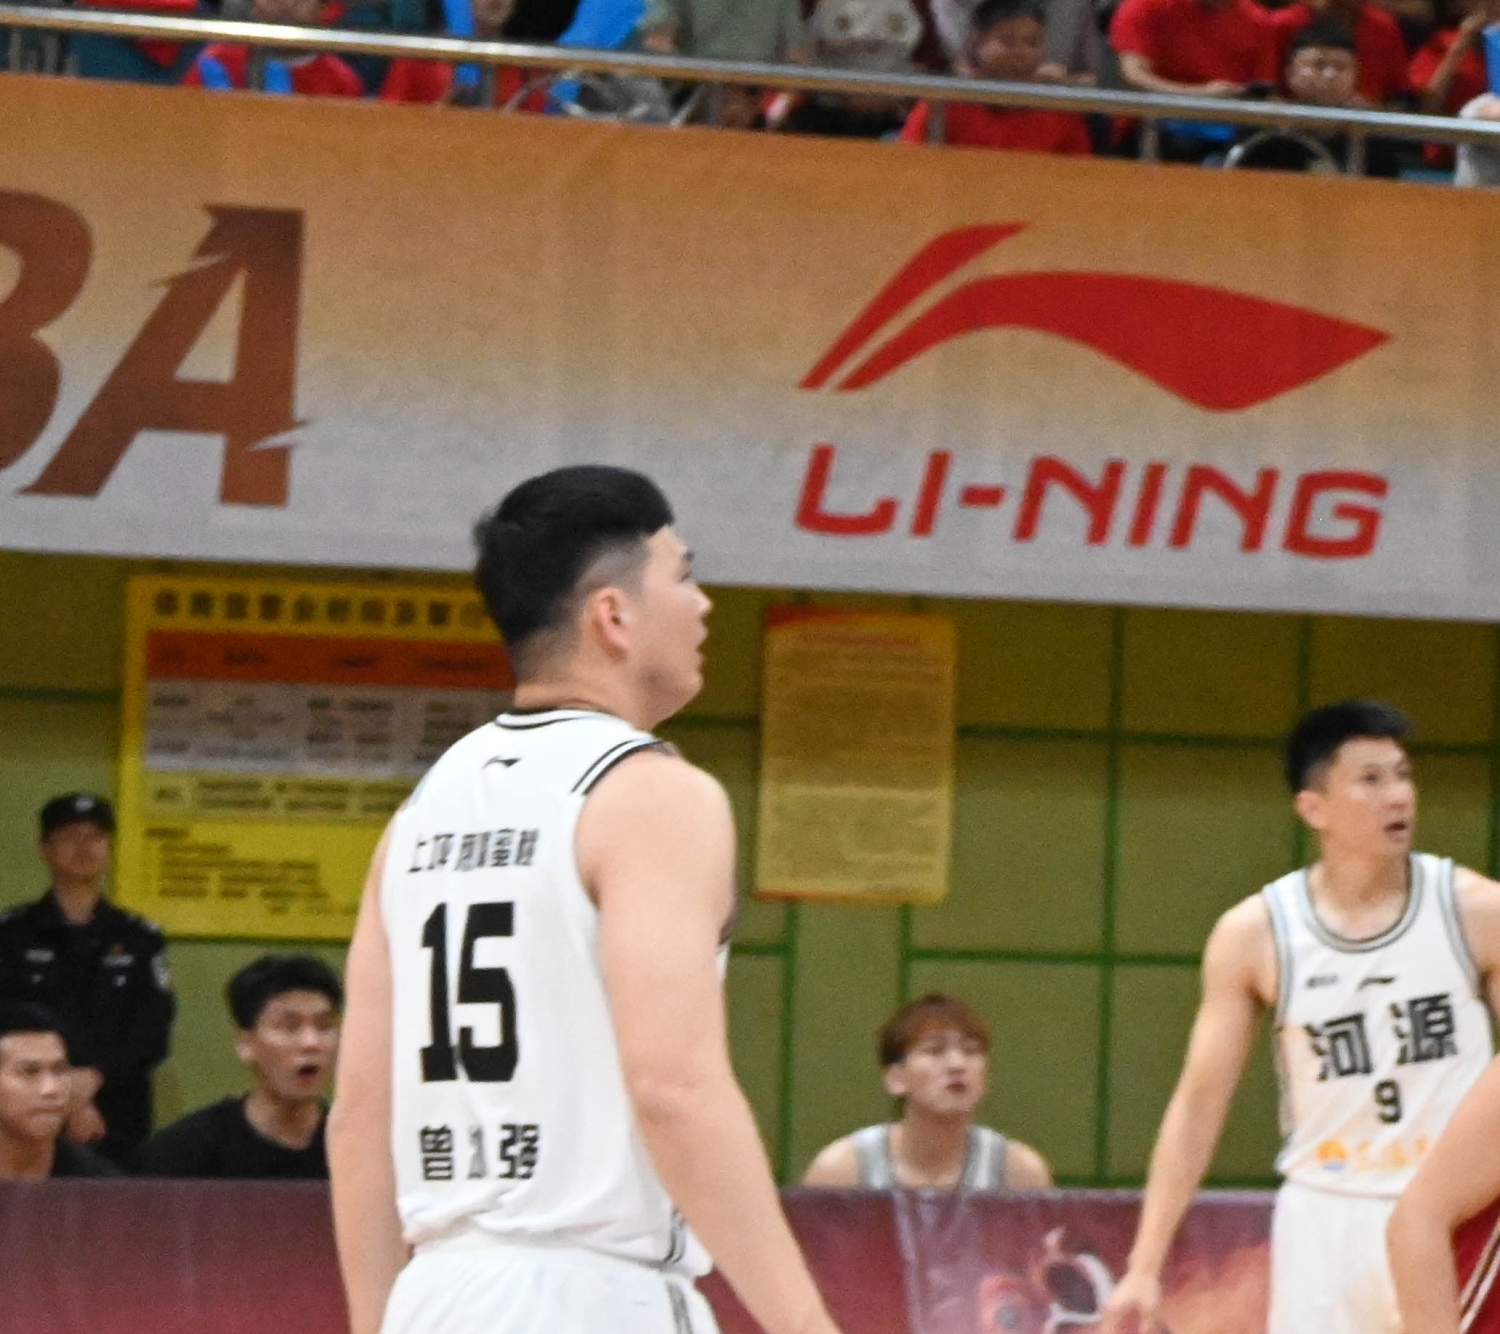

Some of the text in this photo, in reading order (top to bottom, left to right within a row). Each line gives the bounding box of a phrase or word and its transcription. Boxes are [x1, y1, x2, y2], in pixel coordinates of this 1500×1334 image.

[797, 444, 1390, 561] LI-NING
[419, 900, 521, 1083] 15
[1303, 992, 1458, 1083] 河源
[1374, 1078, 1402, 1125] 9
[419, 1123, 540, 1181] 曾强
